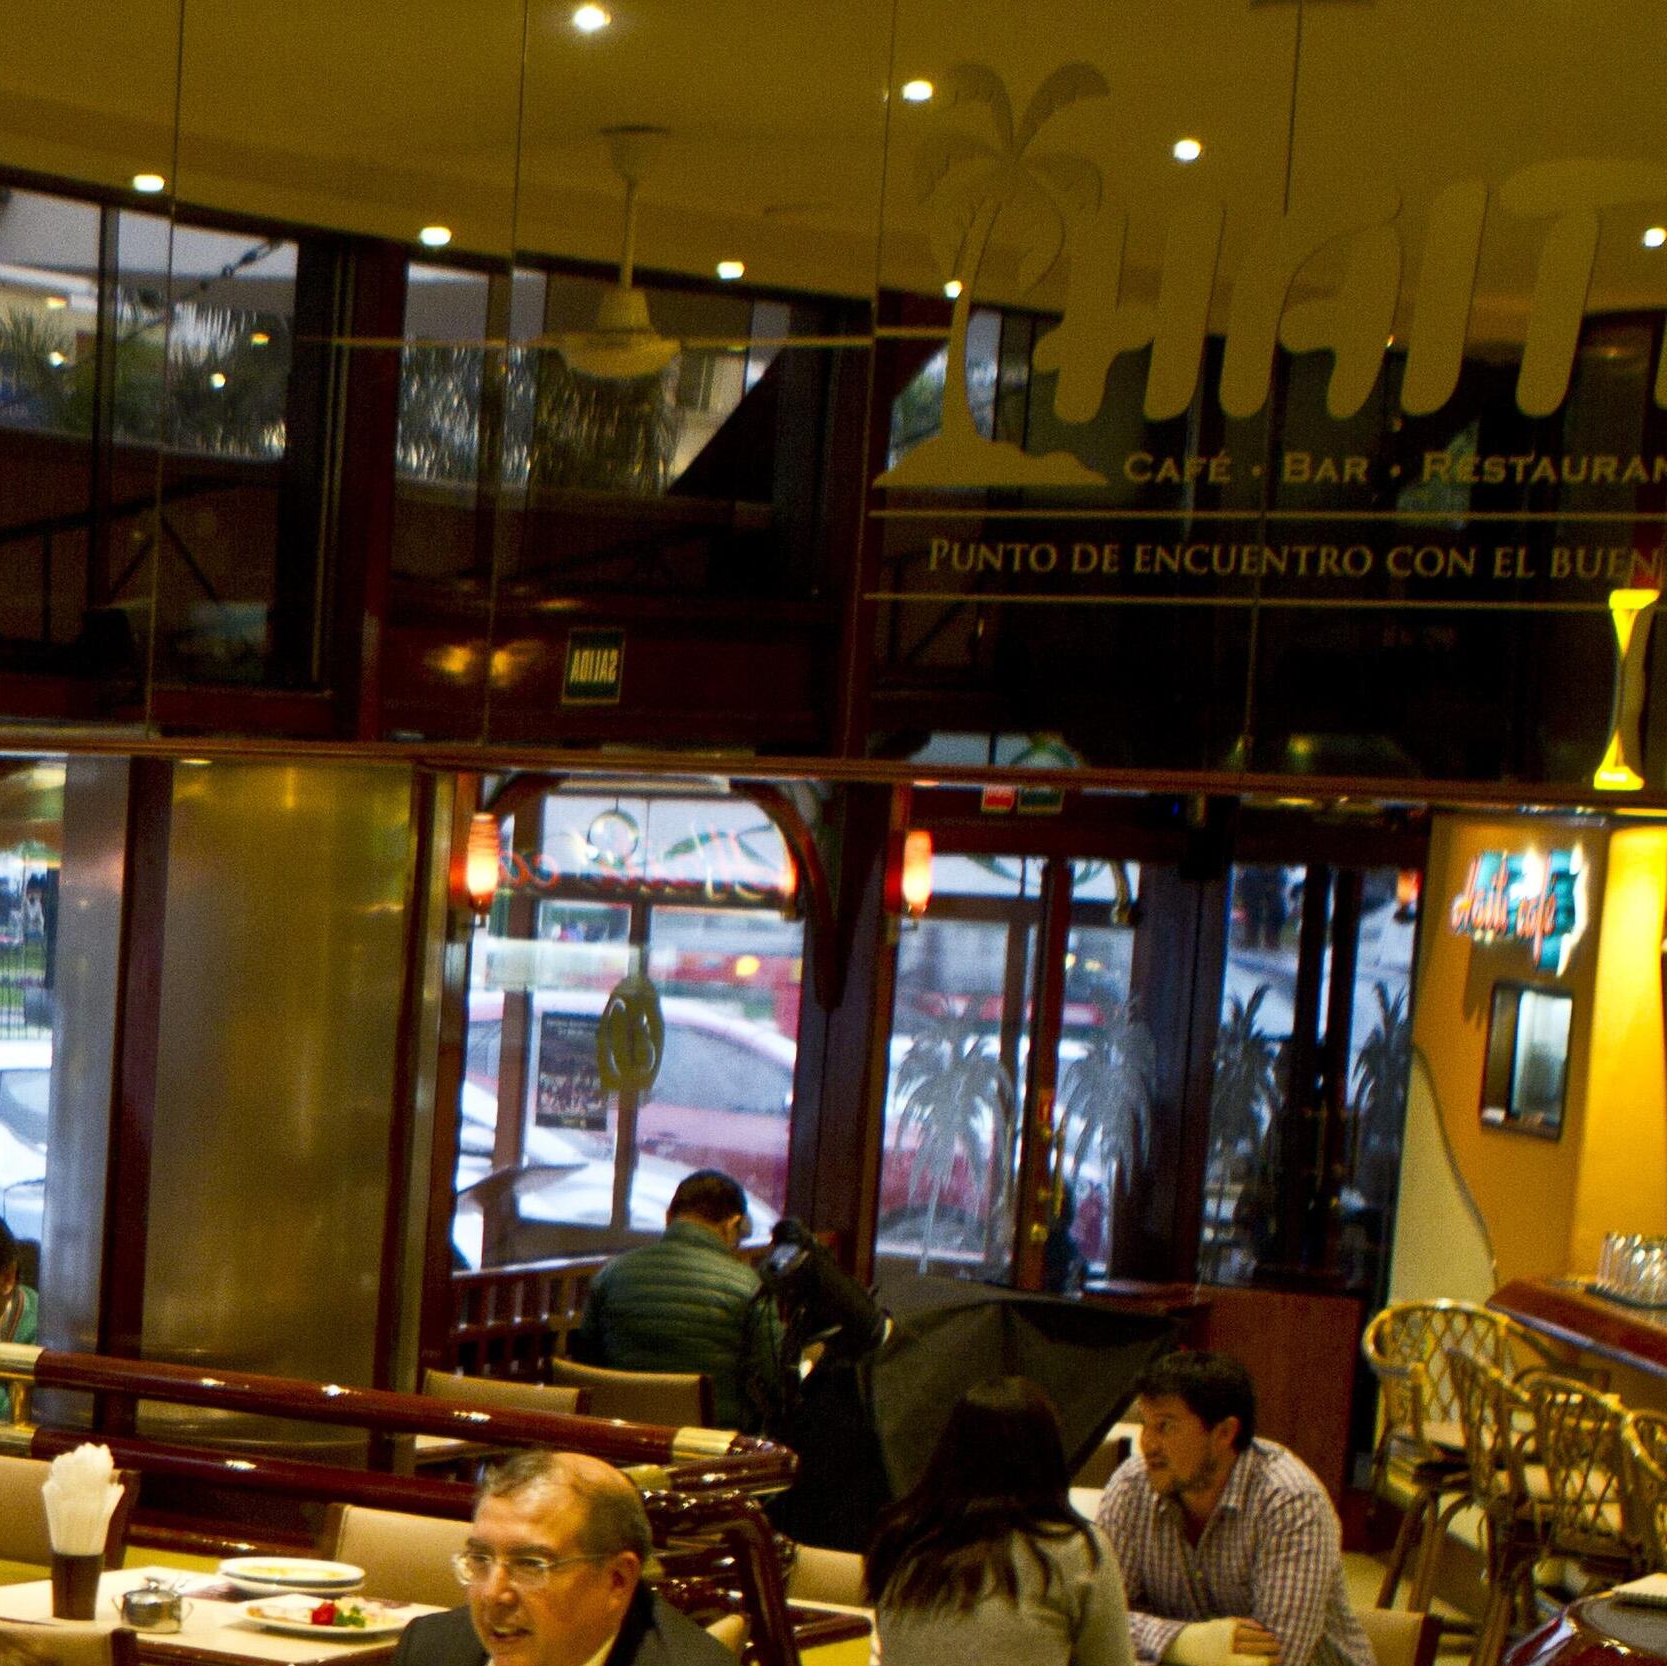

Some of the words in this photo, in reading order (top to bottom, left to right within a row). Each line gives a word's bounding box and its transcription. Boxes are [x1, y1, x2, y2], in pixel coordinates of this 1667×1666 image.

[928, 537, 1058, 575] PUNTO
[1070, 542, 1120, 576] DE
[1132, 543, 1372, 578] ENCUENTRO
[1386, 544, 1475, 578] CON
[1492, 545, 1535, 580] EL
